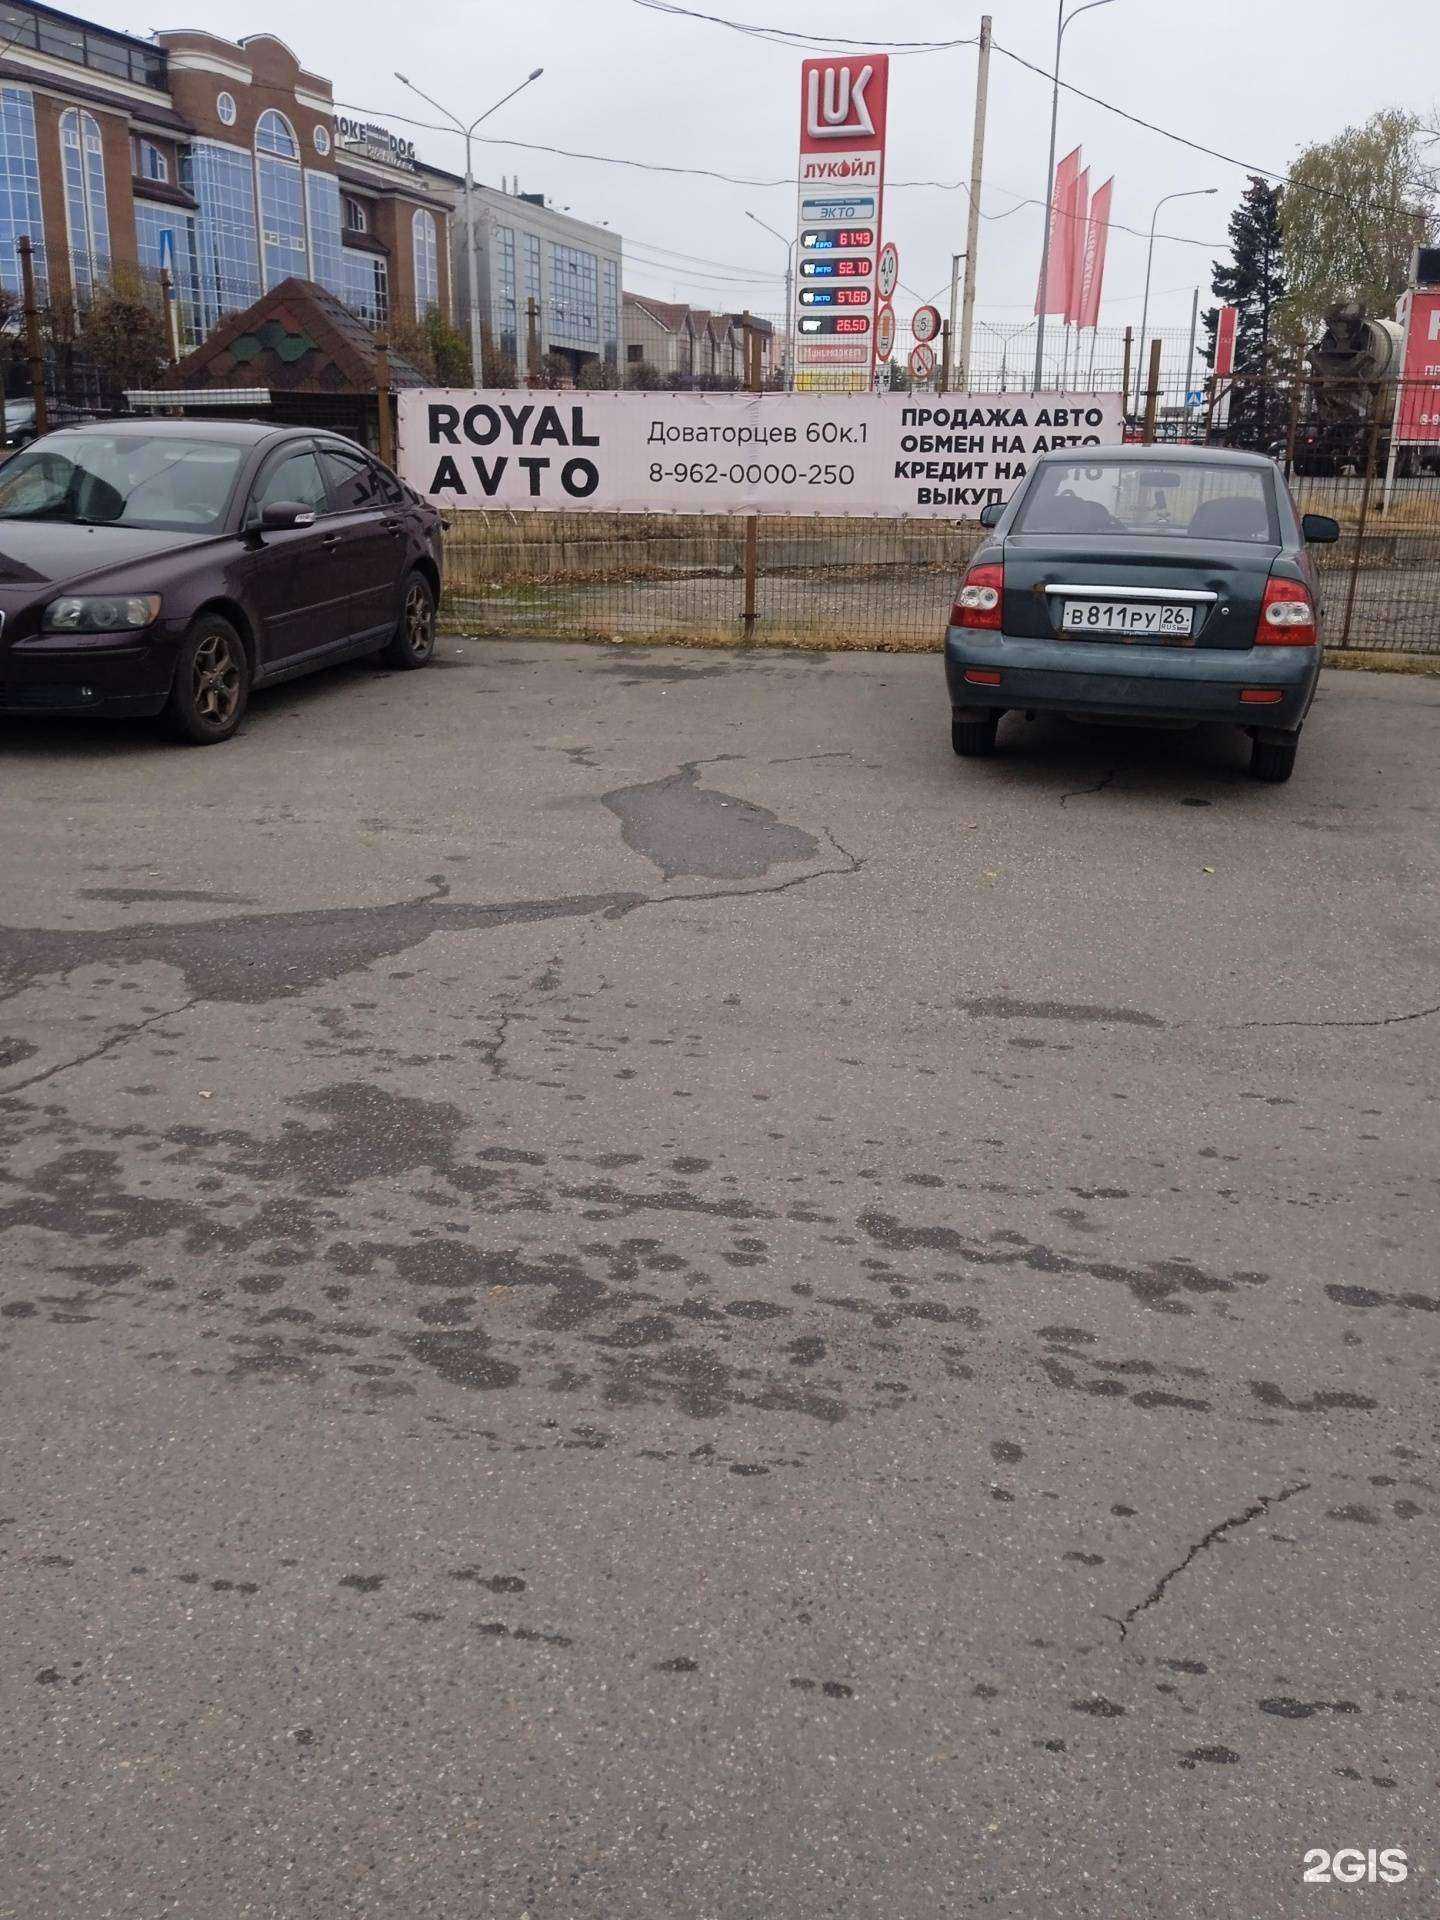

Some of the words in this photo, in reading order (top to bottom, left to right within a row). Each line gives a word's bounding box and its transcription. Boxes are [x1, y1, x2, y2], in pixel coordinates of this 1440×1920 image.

[804, 159, 876, 178] ЛУКОЙЛ
[820, 207, 855, 218] ЭКТО
[840, 233, 870, 245] 61.43
[839, 262, 869, 274] 52.10
[838, 291, 867, 303] 57.68
[836, 319, 867, 331] 26.50
[428, 404, 600, 447] ROYAL
[901, 408, 1029, 430] ПРОДАЖА
[1034, 408, 1103, 427] АВТО
[647, 421, 797, 449] Доваторцев
[805, 422, 869, 444] 60к.1
[900, 435, 984, 453] ОБМЕН
[992, 435, 1026, 453] НА
[429, 455, 600, 498] AVTO
[649, 462, 856, 486] 8-962-0000-250
[894, 461, 988, 482] КРЕДИТ
[995, 462, 1027, 480] НА
[917, 487, 1003, 505] ВЫКУП
[1071, 606, 1157, 629] В811РУ
[1163, 608, 1184, 625] 26
